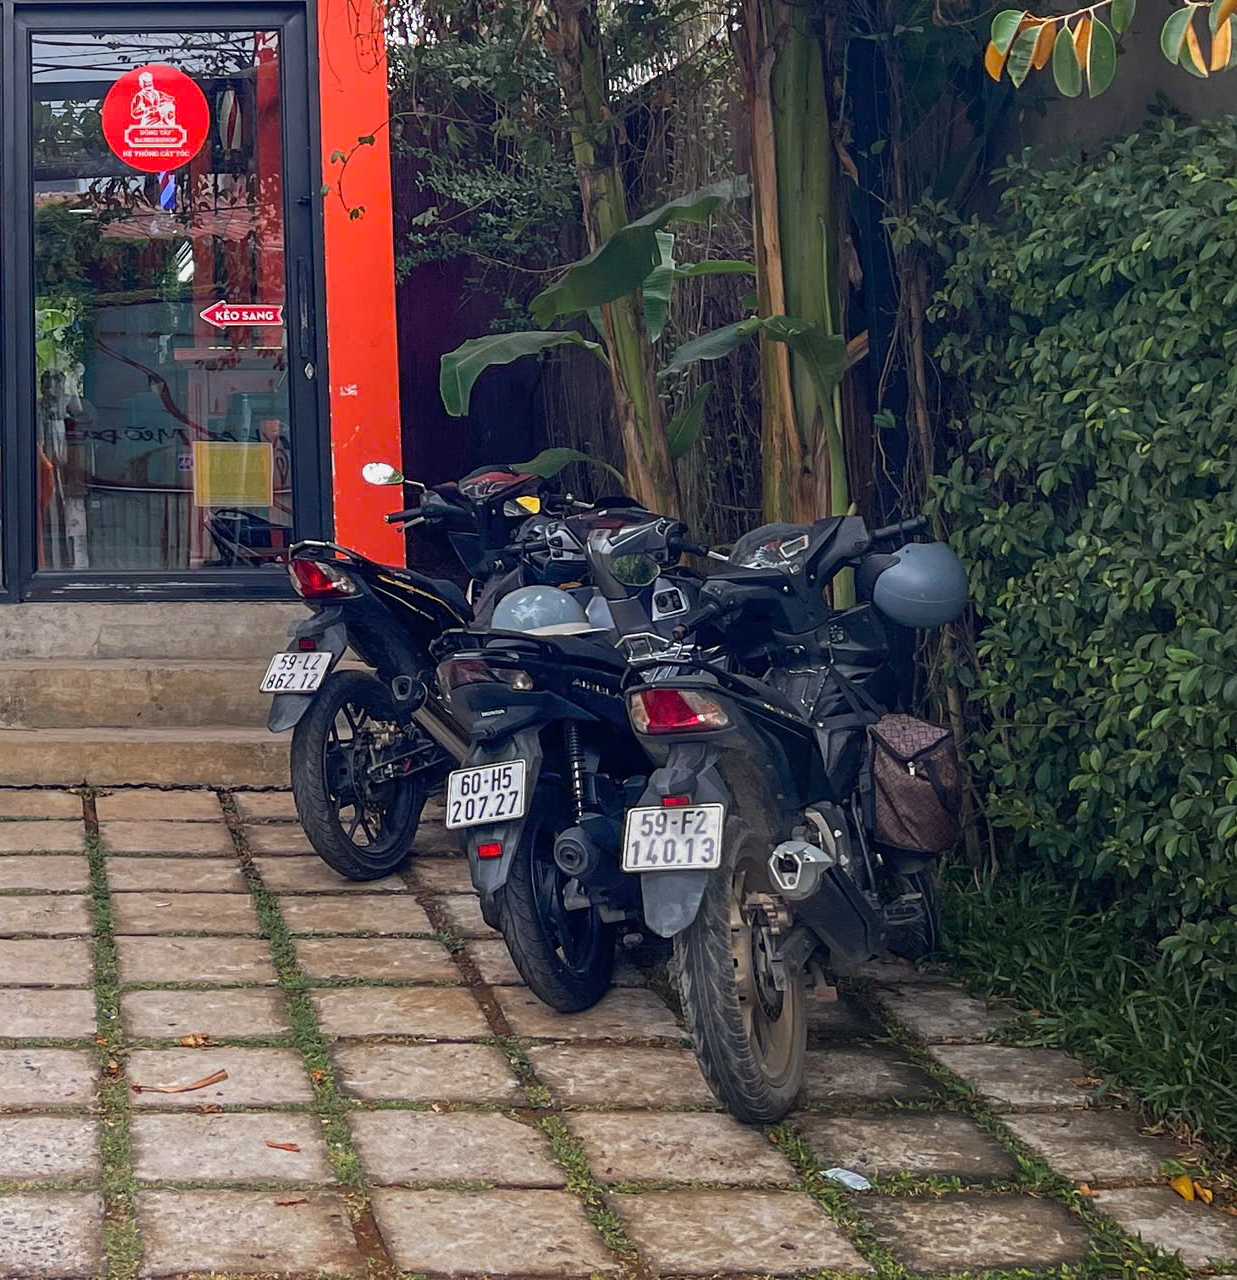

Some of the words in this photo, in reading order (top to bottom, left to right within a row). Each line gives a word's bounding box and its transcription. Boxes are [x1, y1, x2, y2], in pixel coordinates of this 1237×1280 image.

[215, 308, 240, 321] KÉO
[241, 311, 274, 321] SANG
[278, 654, 323, 670] 59-L2
[266, 672, 319, 689] 862.12
[461, 767, 513, 797] 60-H5
[452, 790, 520, 824] 207.27
[641, 810, 708, 837] 59-F2
[631, 837, 716, 866] 140.13
